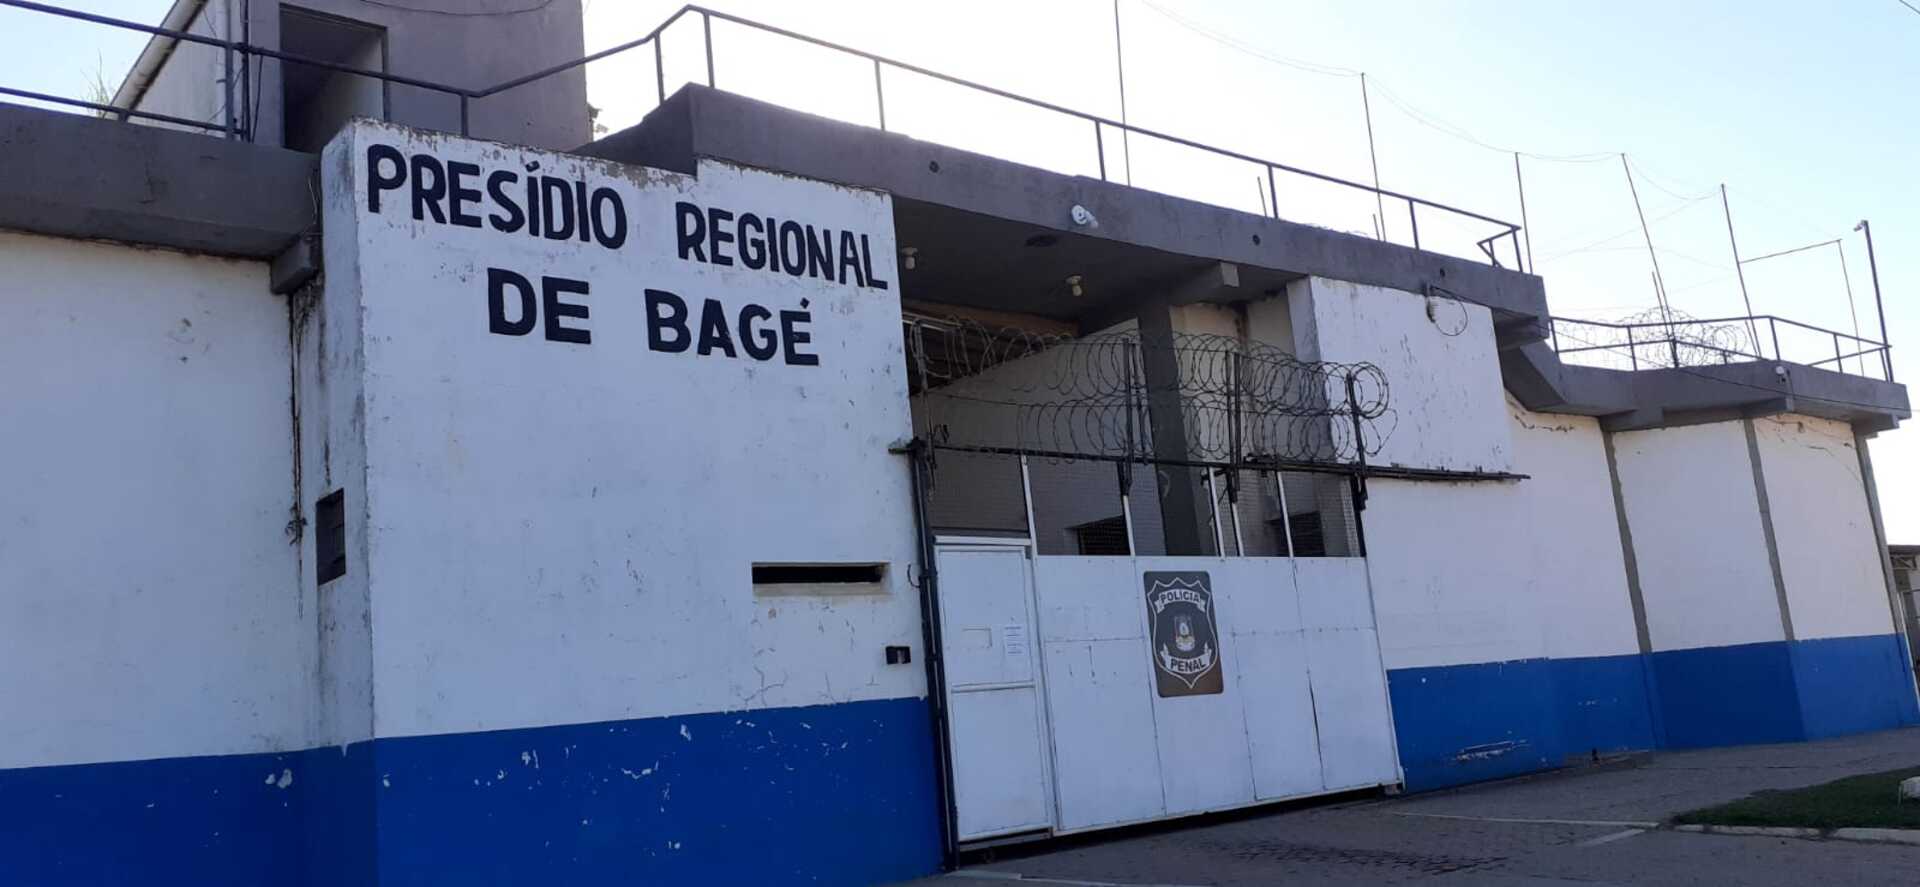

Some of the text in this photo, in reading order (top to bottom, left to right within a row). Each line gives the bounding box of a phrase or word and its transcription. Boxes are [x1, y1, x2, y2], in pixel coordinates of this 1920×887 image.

[367, 144, 887, 289] PRESÍDIO REGIONAL
[487, 268, 819, 366] DE BAGÉ
[1171, 658, 1206, 672] PENAL
